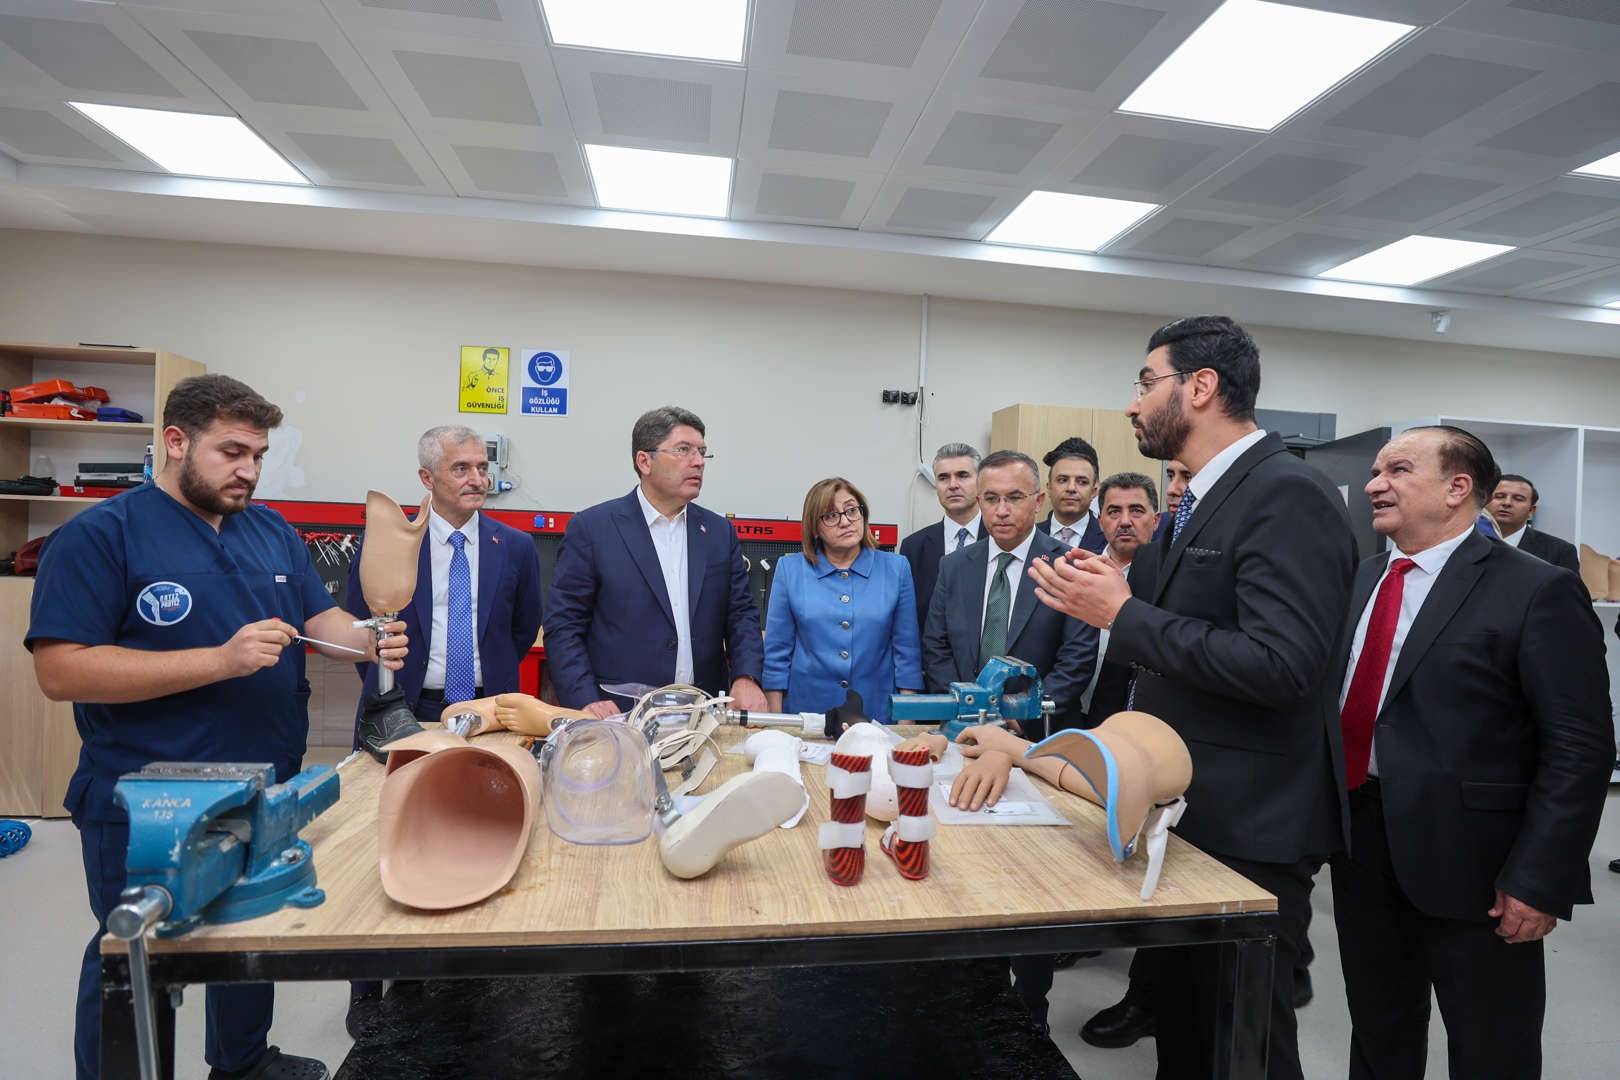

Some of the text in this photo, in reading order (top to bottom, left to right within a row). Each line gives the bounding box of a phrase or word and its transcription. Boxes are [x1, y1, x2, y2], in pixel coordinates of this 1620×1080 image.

[541, 389, 549, 397] İŞ
[529, 397, 560, 405] GÖZLÜĞÜ
[735, 525, 773, 534] LTAS
[141, 797, 192, 808] KANCA
